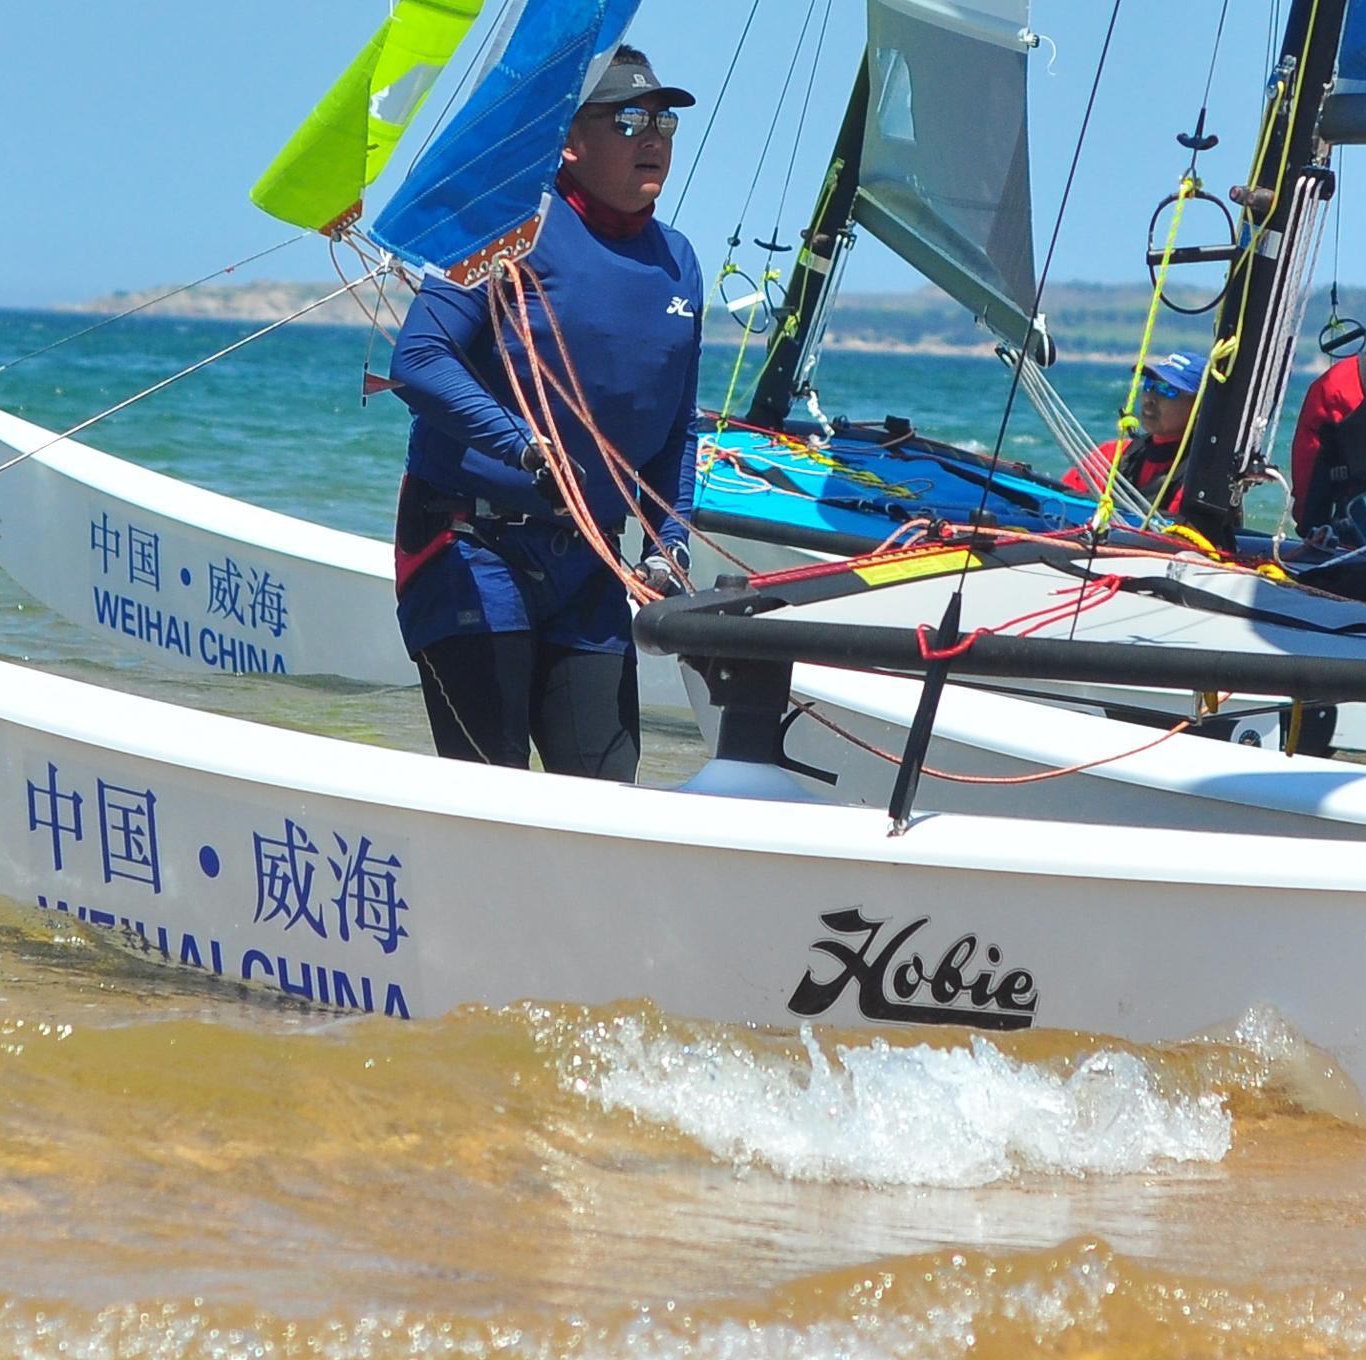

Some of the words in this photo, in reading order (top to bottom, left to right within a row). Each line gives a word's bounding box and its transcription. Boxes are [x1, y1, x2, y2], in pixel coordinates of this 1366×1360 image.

[93, 585, 191, 657] WEIHAI
[199, 626, 286, 674] CHINA
[788, 906, 1039, 1031] Hobie
